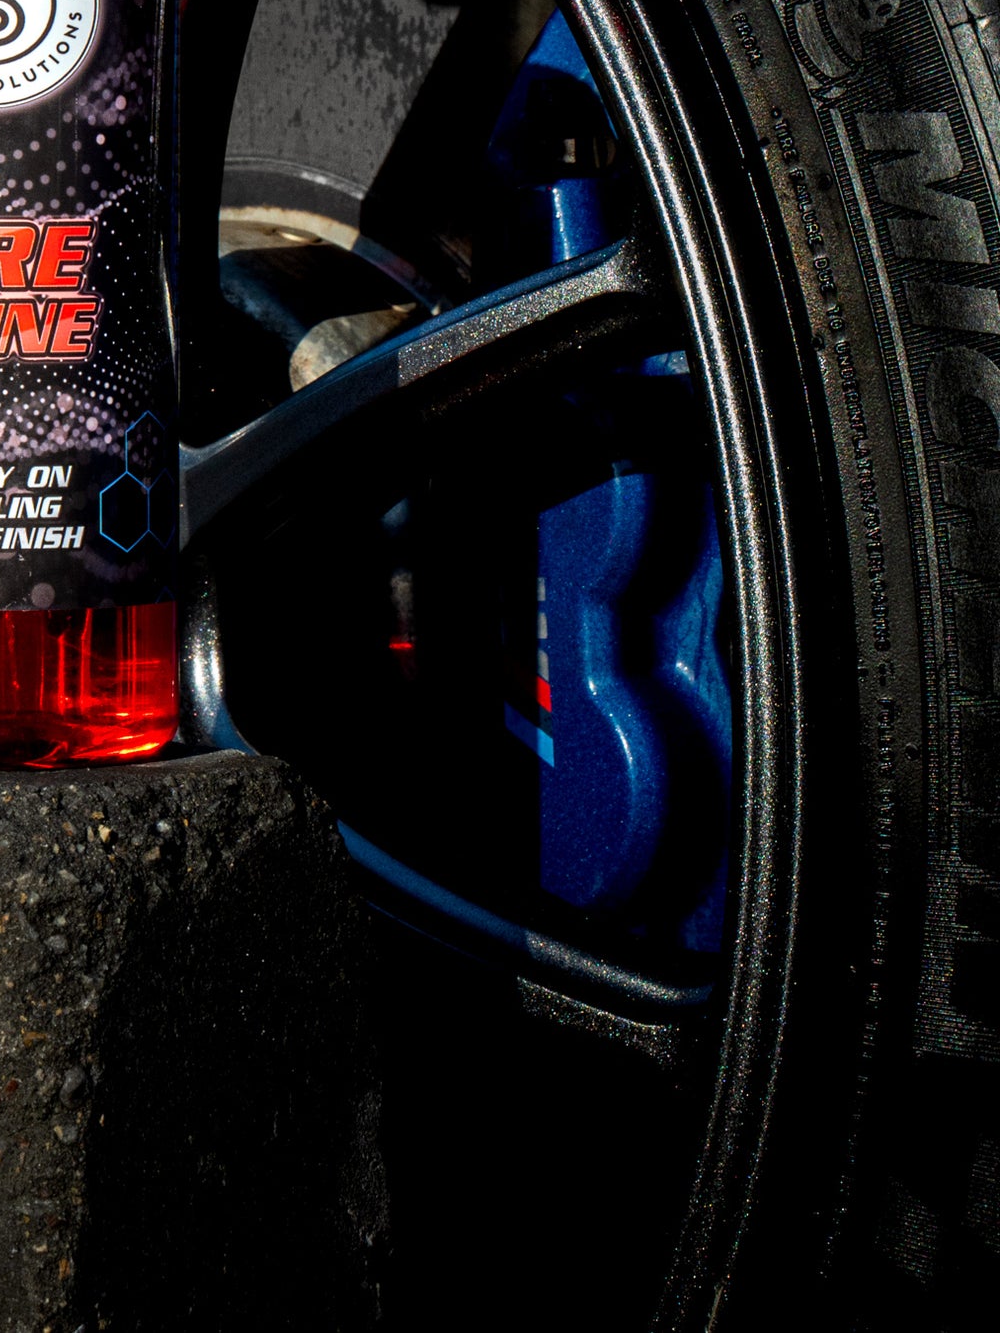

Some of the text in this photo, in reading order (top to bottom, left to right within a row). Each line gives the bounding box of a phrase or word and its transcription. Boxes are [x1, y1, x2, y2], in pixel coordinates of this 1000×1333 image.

[788, 168, 824, 247] FAILURE
[812, 257, 838, 297] DUE
[826, 304, 846, 332] TO
[26, 464, 73, 489] ON
